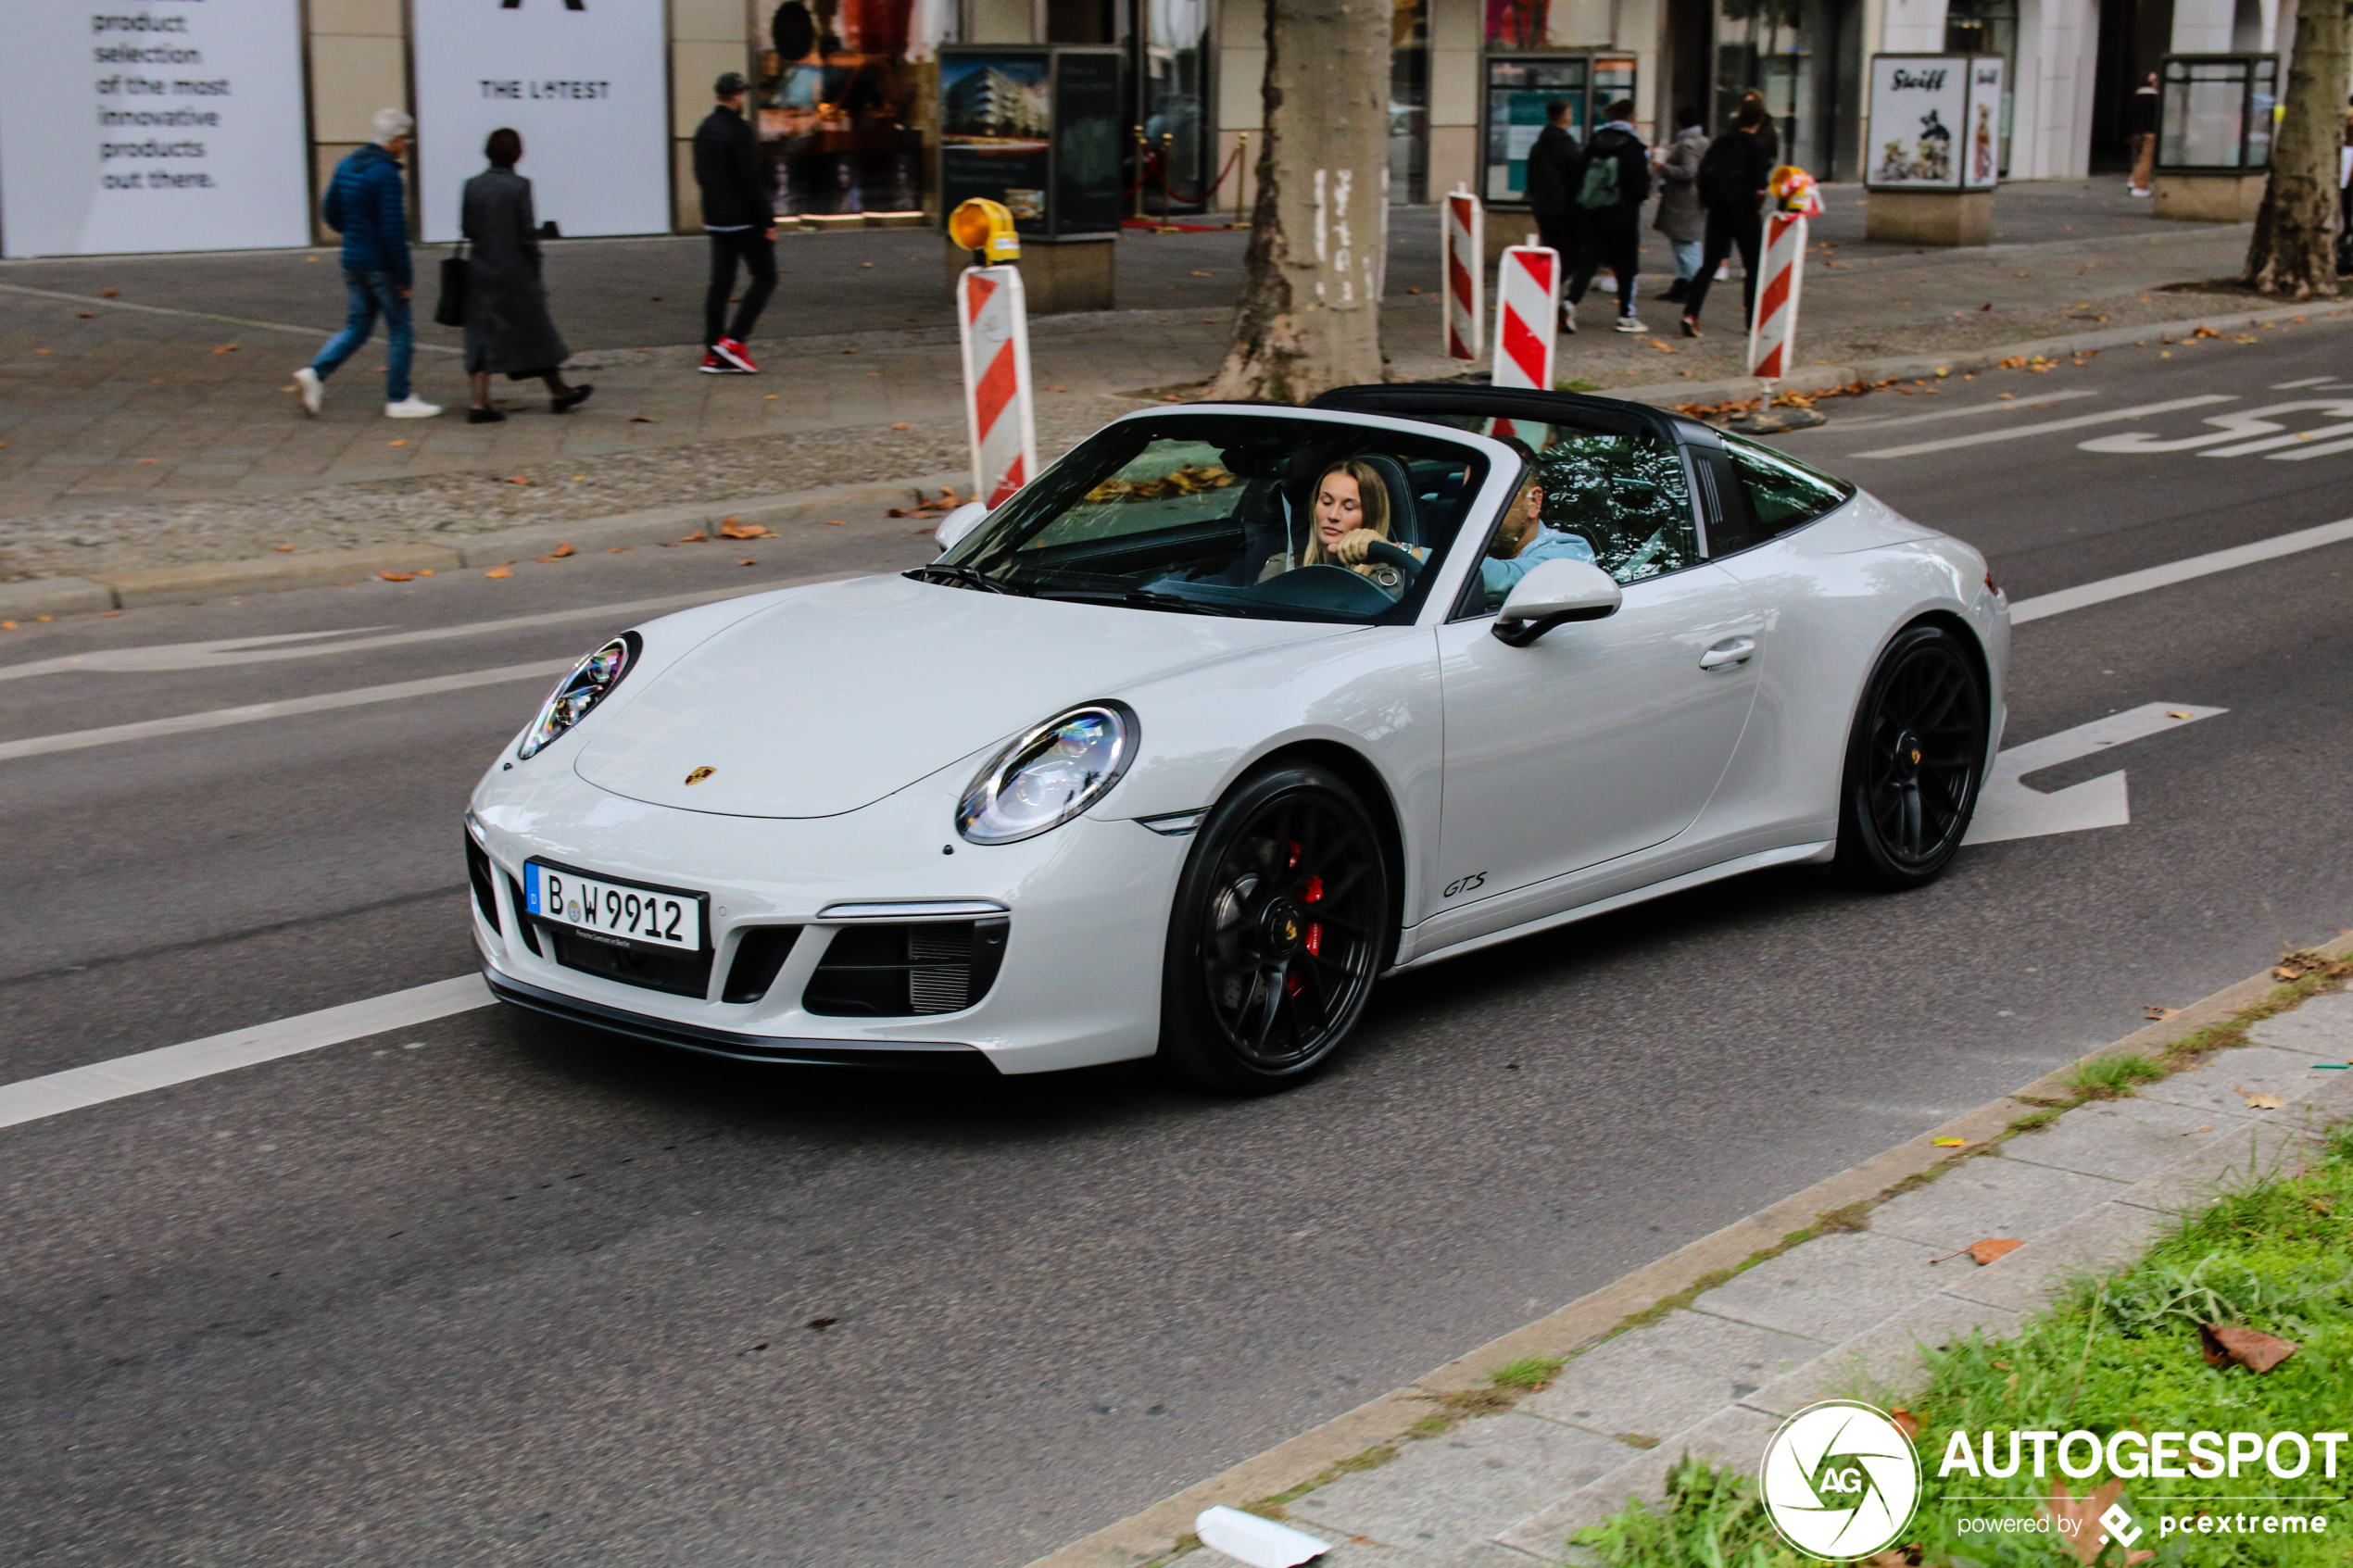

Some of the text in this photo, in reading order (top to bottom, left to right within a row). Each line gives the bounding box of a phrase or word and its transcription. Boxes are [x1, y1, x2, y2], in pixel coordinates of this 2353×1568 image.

[91, 12, 186, 35] product
[94, 44, 201, 64] selection
[96, 74, 230, 95] of the most
[480, 81, 610, 99] THE LATEST
[97, 105, 220, 127] innovative
[99, 139, 207, 163] products
[102, 172, 142, 189] out
[1548, 491, 1579, 503] GTS
[1443, 871, 1488, 897] GTS
[606, 890, 684, 943] 9912
